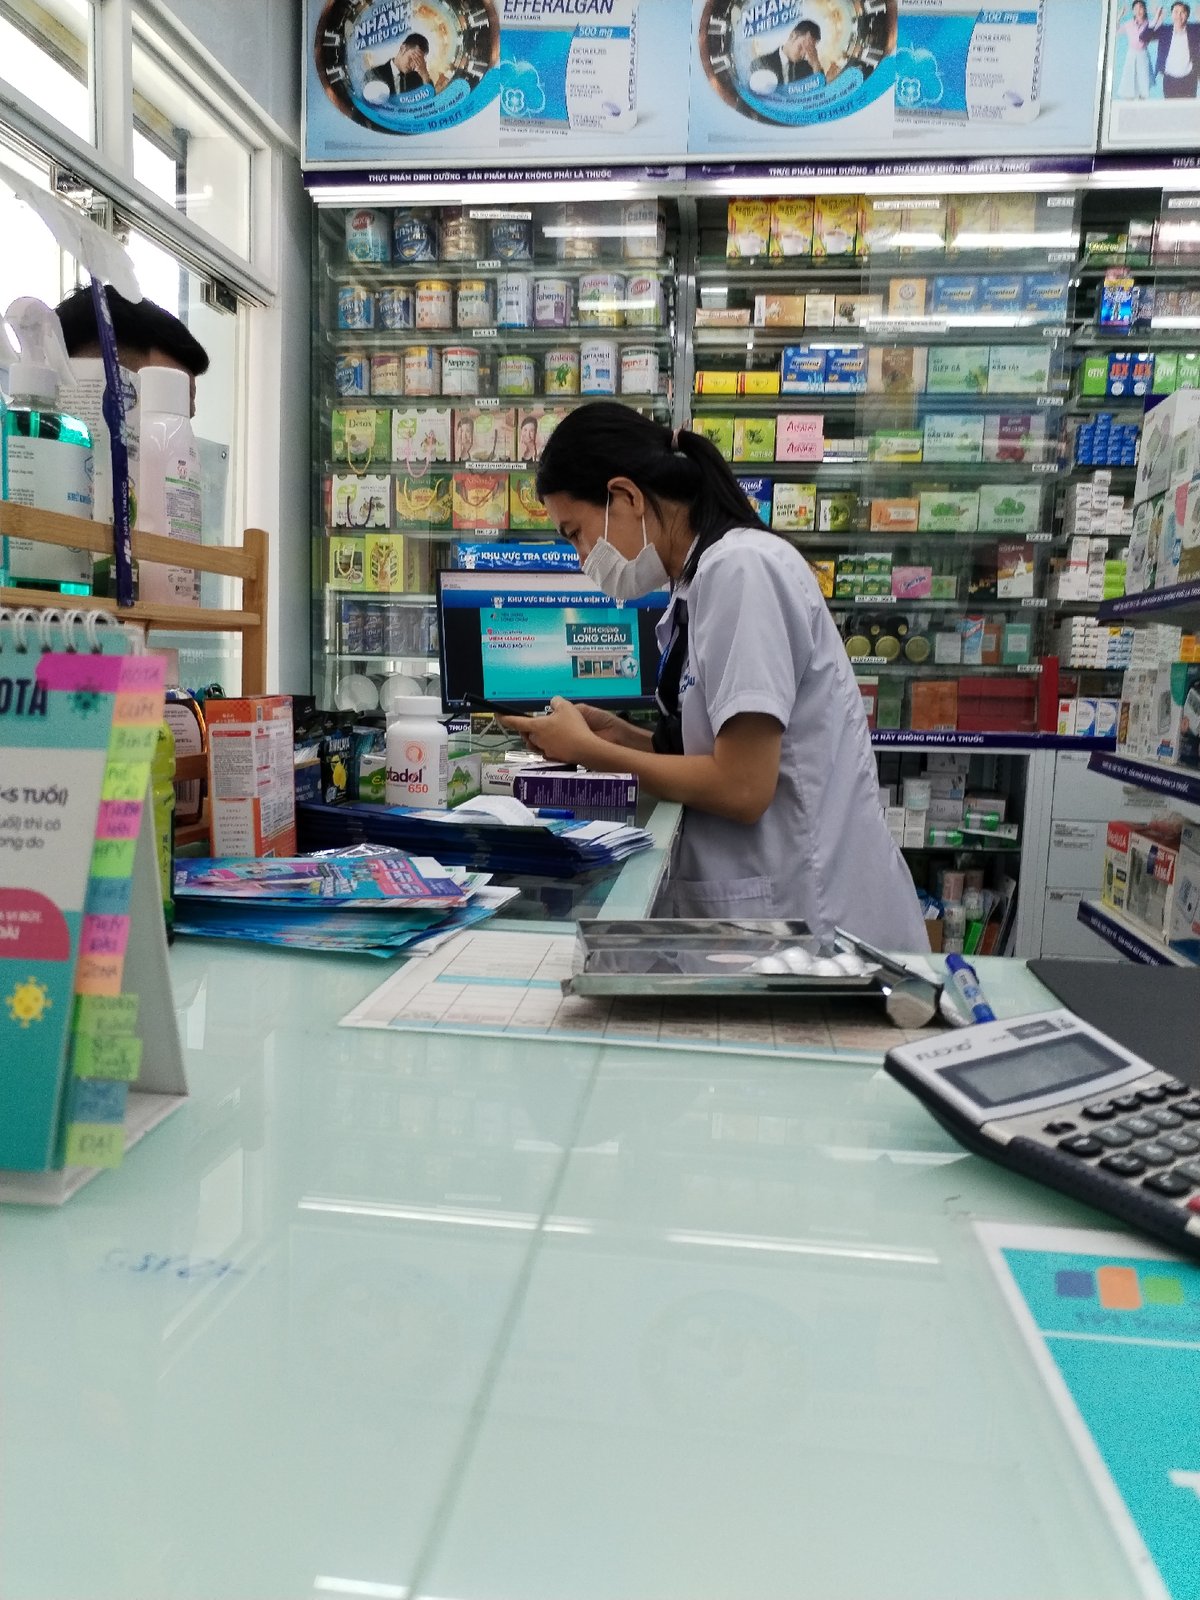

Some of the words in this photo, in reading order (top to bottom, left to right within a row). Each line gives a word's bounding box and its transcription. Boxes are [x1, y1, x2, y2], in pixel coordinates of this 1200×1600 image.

[481, 552, 499, 560] KHU
[502, 551, 520, 562] VỰC
[573, 634, 599, 643] LONG
[600, 632, 627, 643] CHÂU
[0, 678, 48, 716] OTA
[897, 732, 925, 742] KHÔNG
[408, 784, 429, 793] 650
